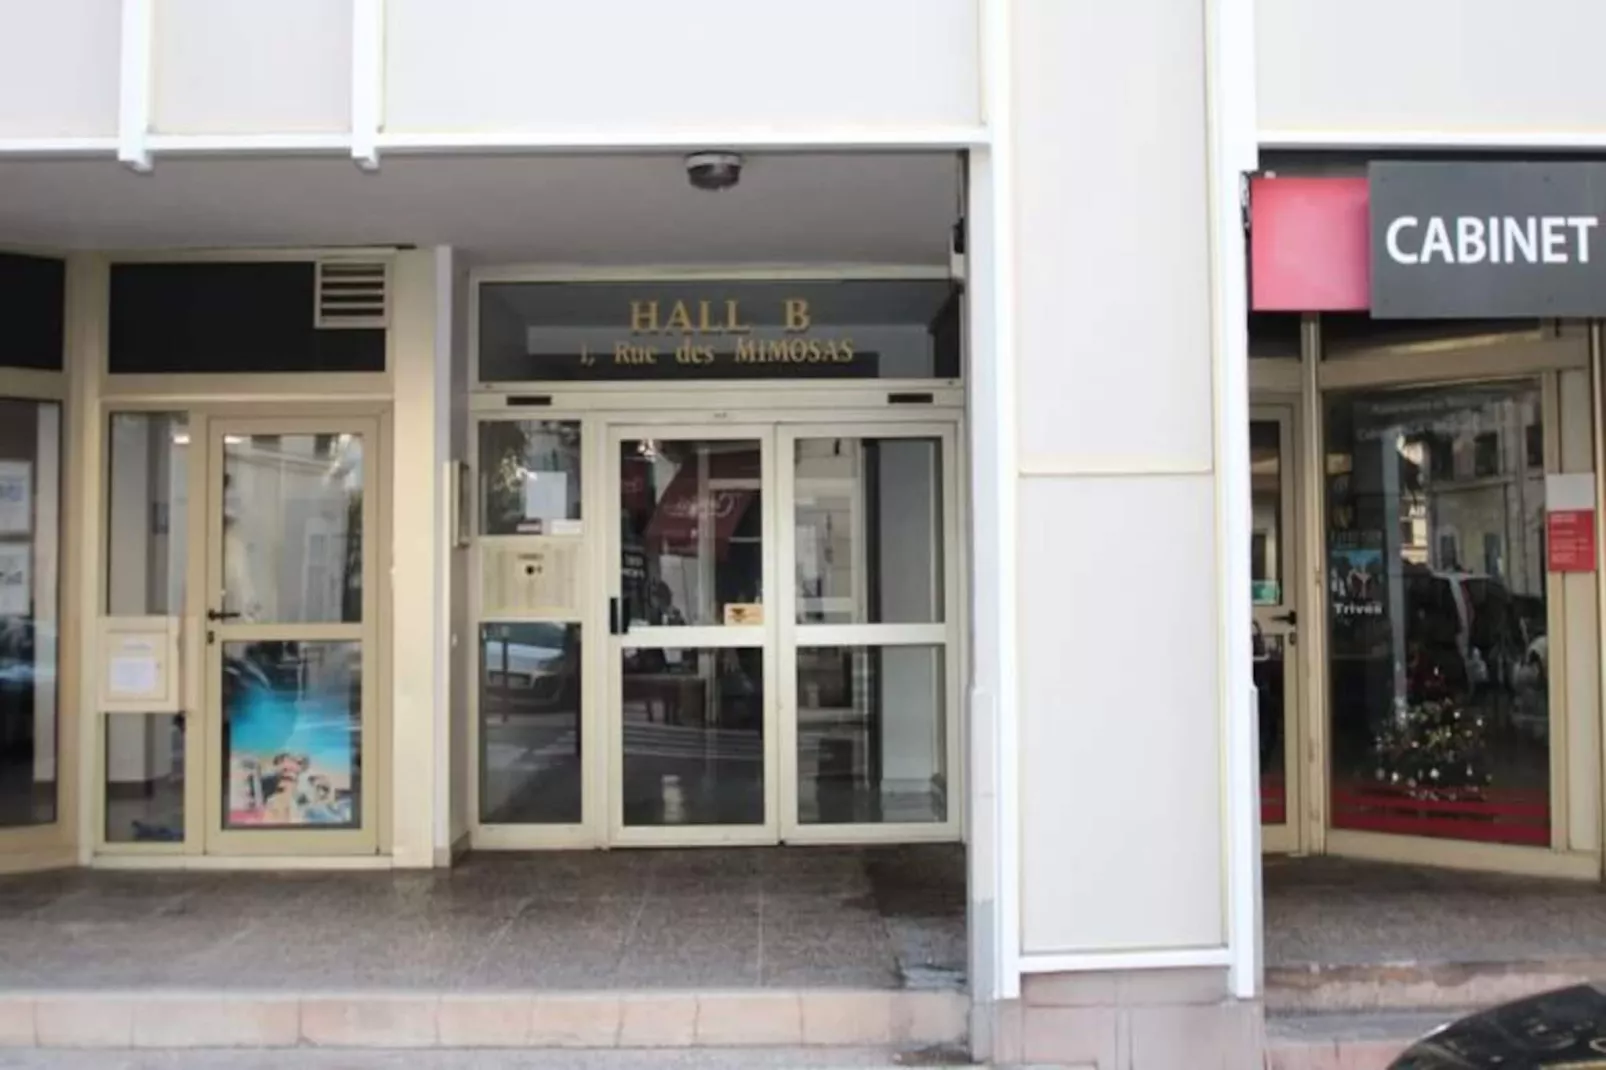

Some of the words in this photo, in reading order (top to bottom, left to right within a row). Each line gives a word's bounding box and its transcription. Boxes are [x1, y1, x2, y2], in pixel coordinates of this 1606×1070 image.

[1385, 215, 1599, 265] CABINET
[630, 299, 751, 333] HALL
[784, 298, 812, 333] B
[613, 341, 657, 365] Rue
[675, 337, 715, 365] des
